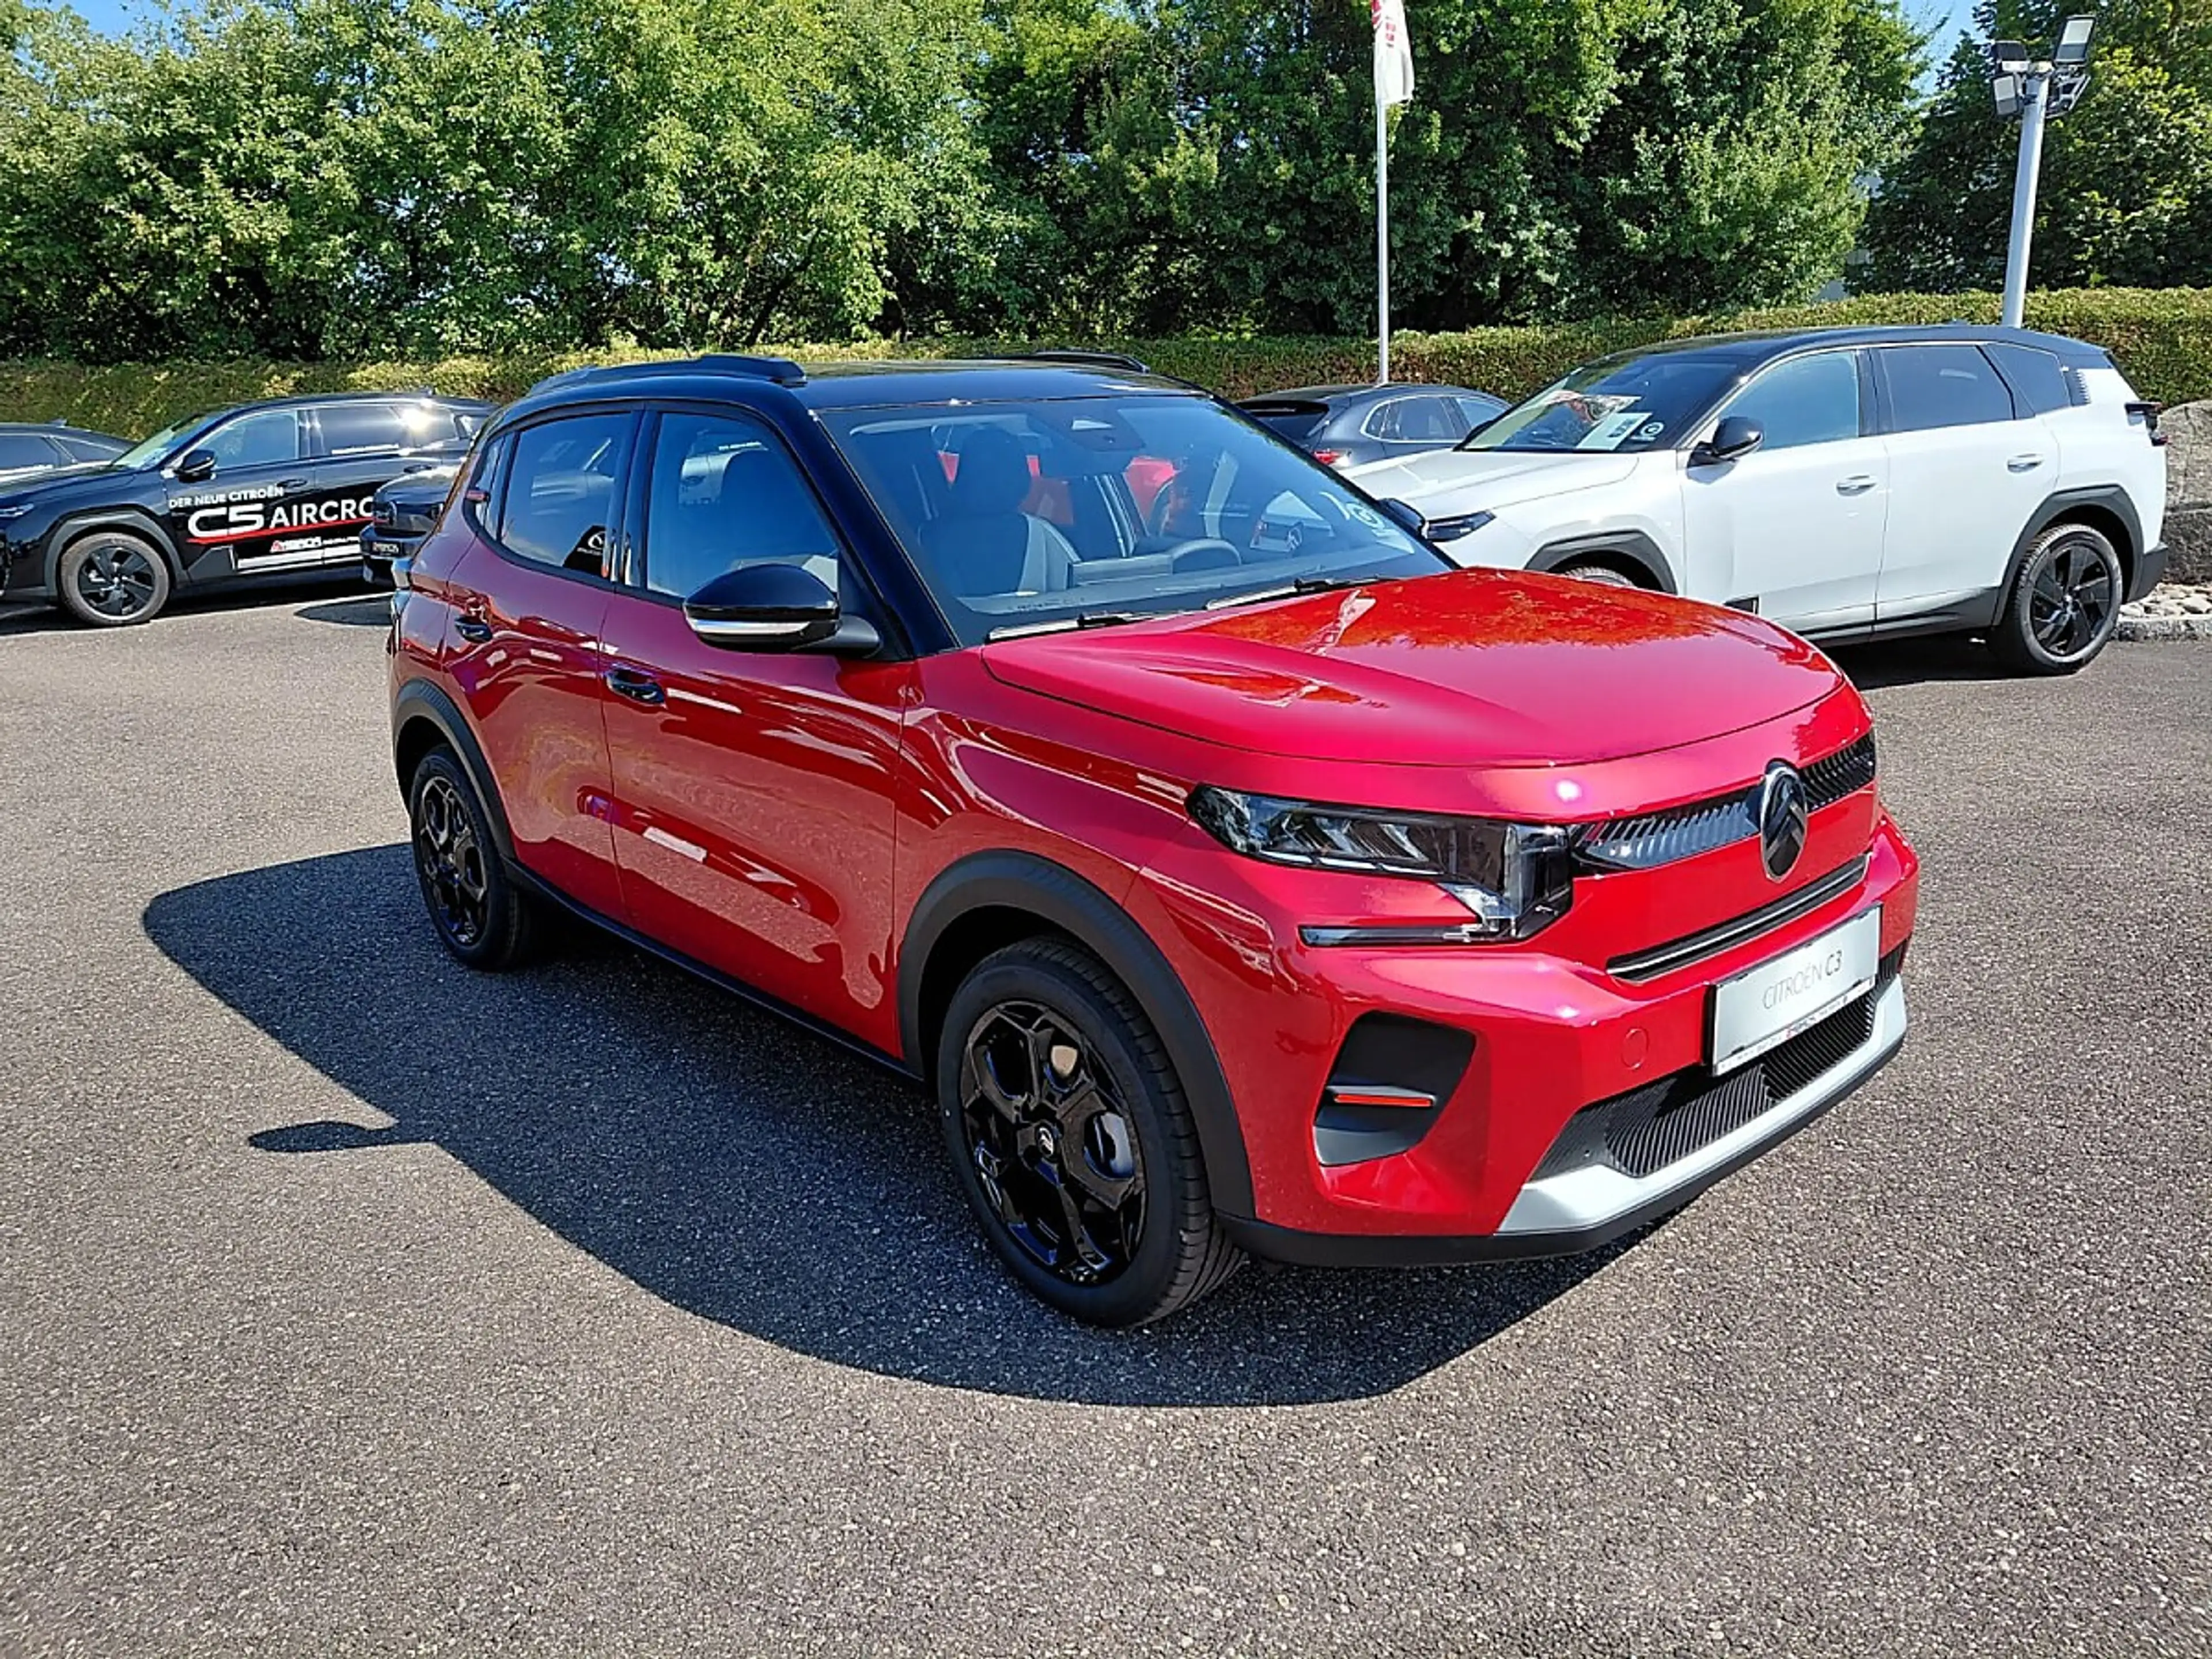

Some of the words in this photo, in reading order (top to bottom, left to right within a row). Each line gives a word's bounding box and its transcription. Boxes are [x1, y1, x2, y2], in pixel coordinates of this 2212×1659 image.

[169, 497, 192, 509] DER
[194, 494, 226, 505] NEUE
[188, 503, 264, 538] C5
[1824, 950, 1842, 976] C3
